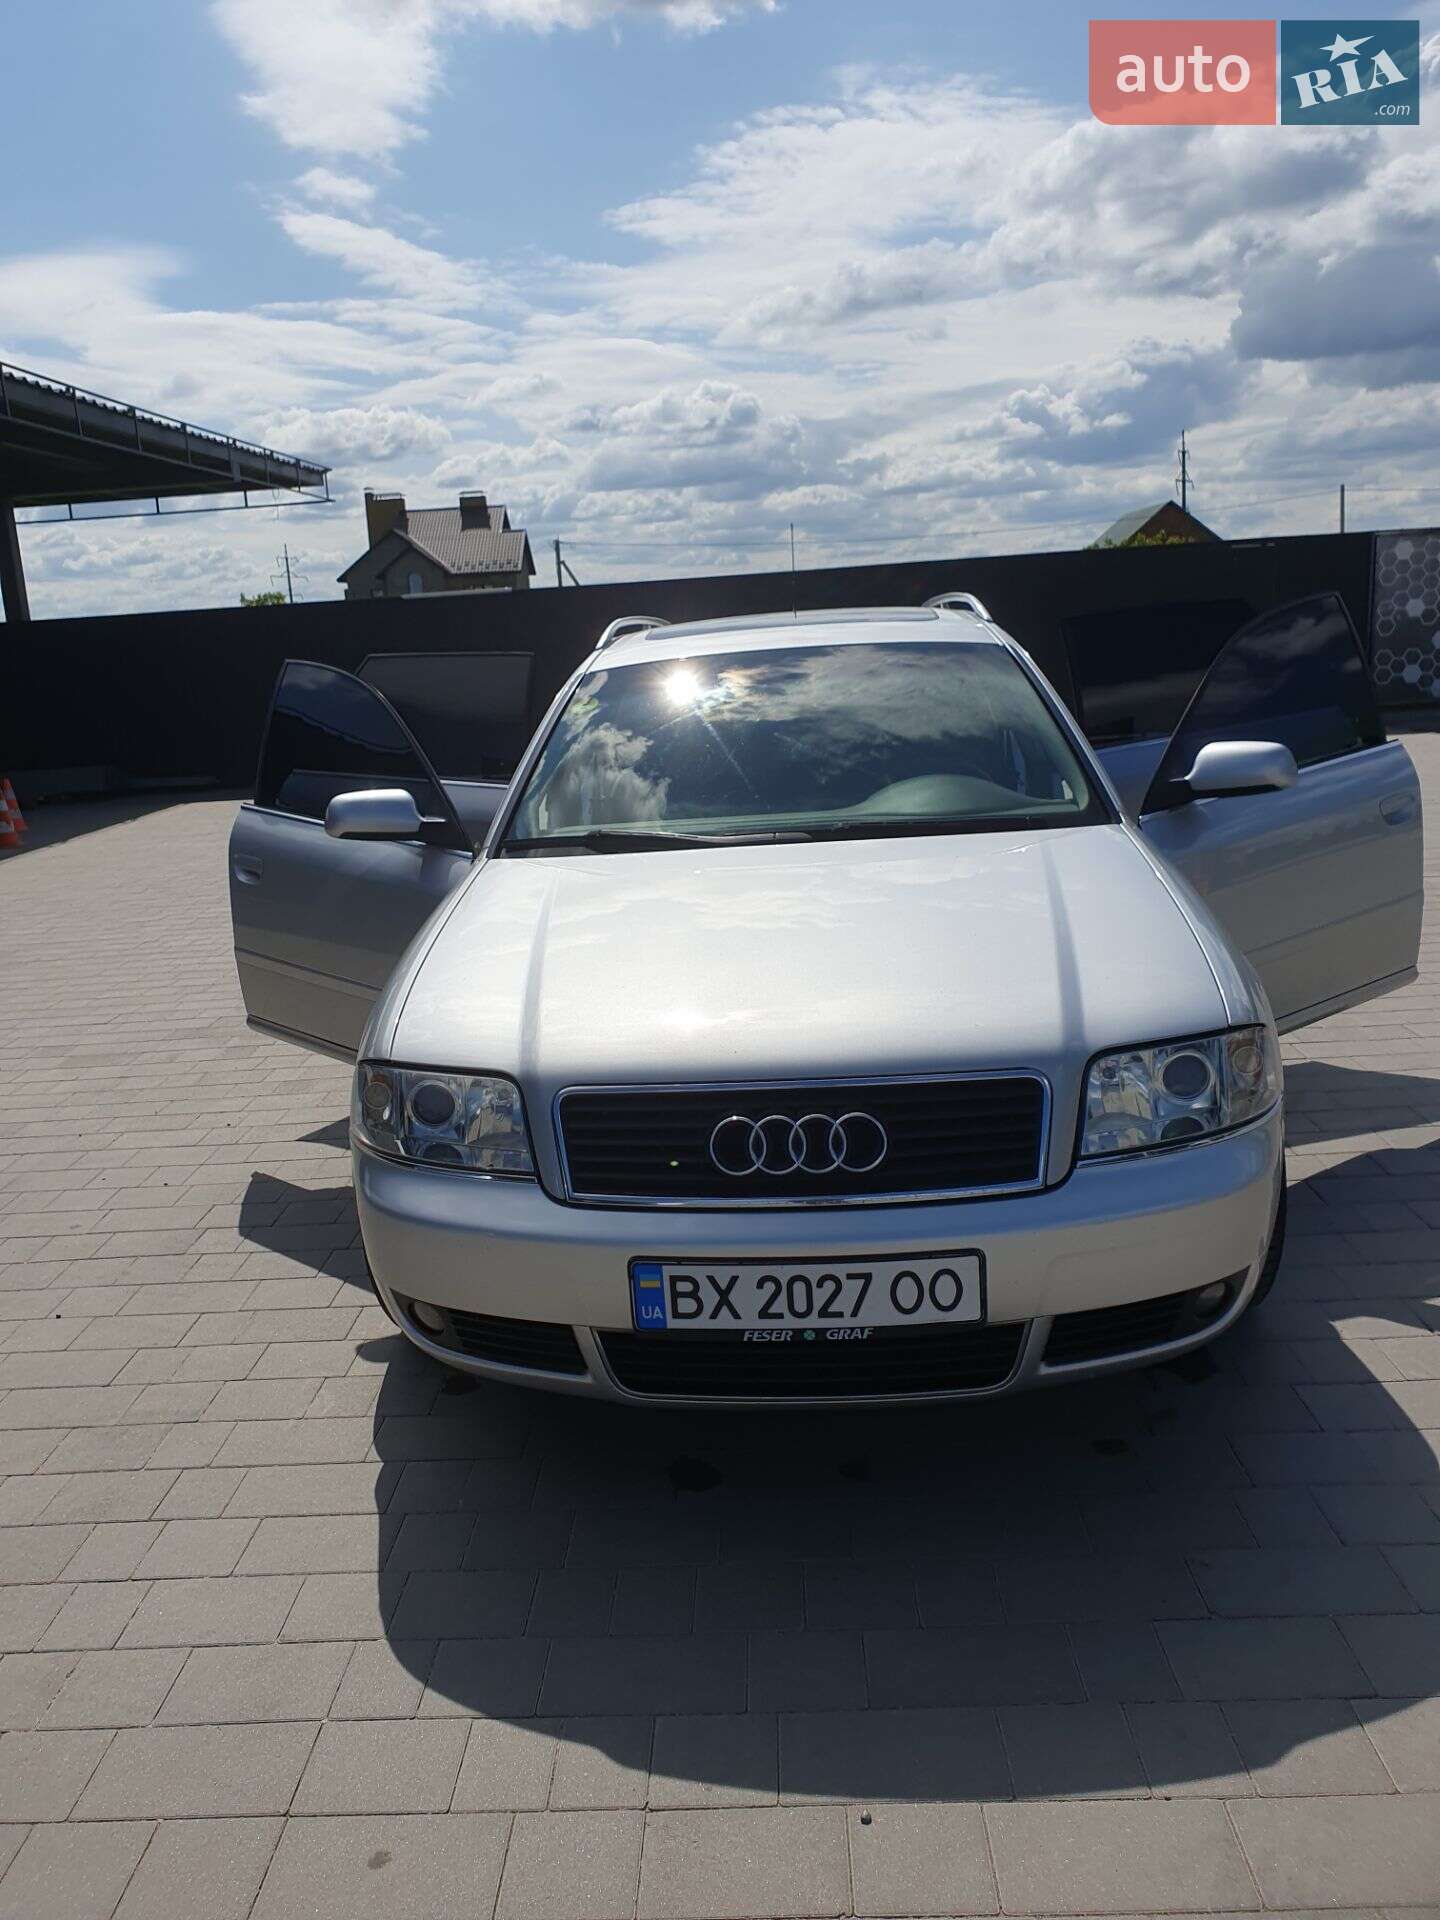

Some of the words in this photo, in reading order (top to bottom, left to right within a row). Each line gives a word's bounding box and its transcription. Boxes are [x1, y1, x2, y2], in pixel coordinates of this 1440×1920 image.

[668, 1274, 742, 1321] BX
[756, 1272, 873, 1320] 2027
[642, 1305, 664, 1320] UA
[743, 1329, 793, 1342] FESER
[826, 1327, 875, 1340] GRAF
